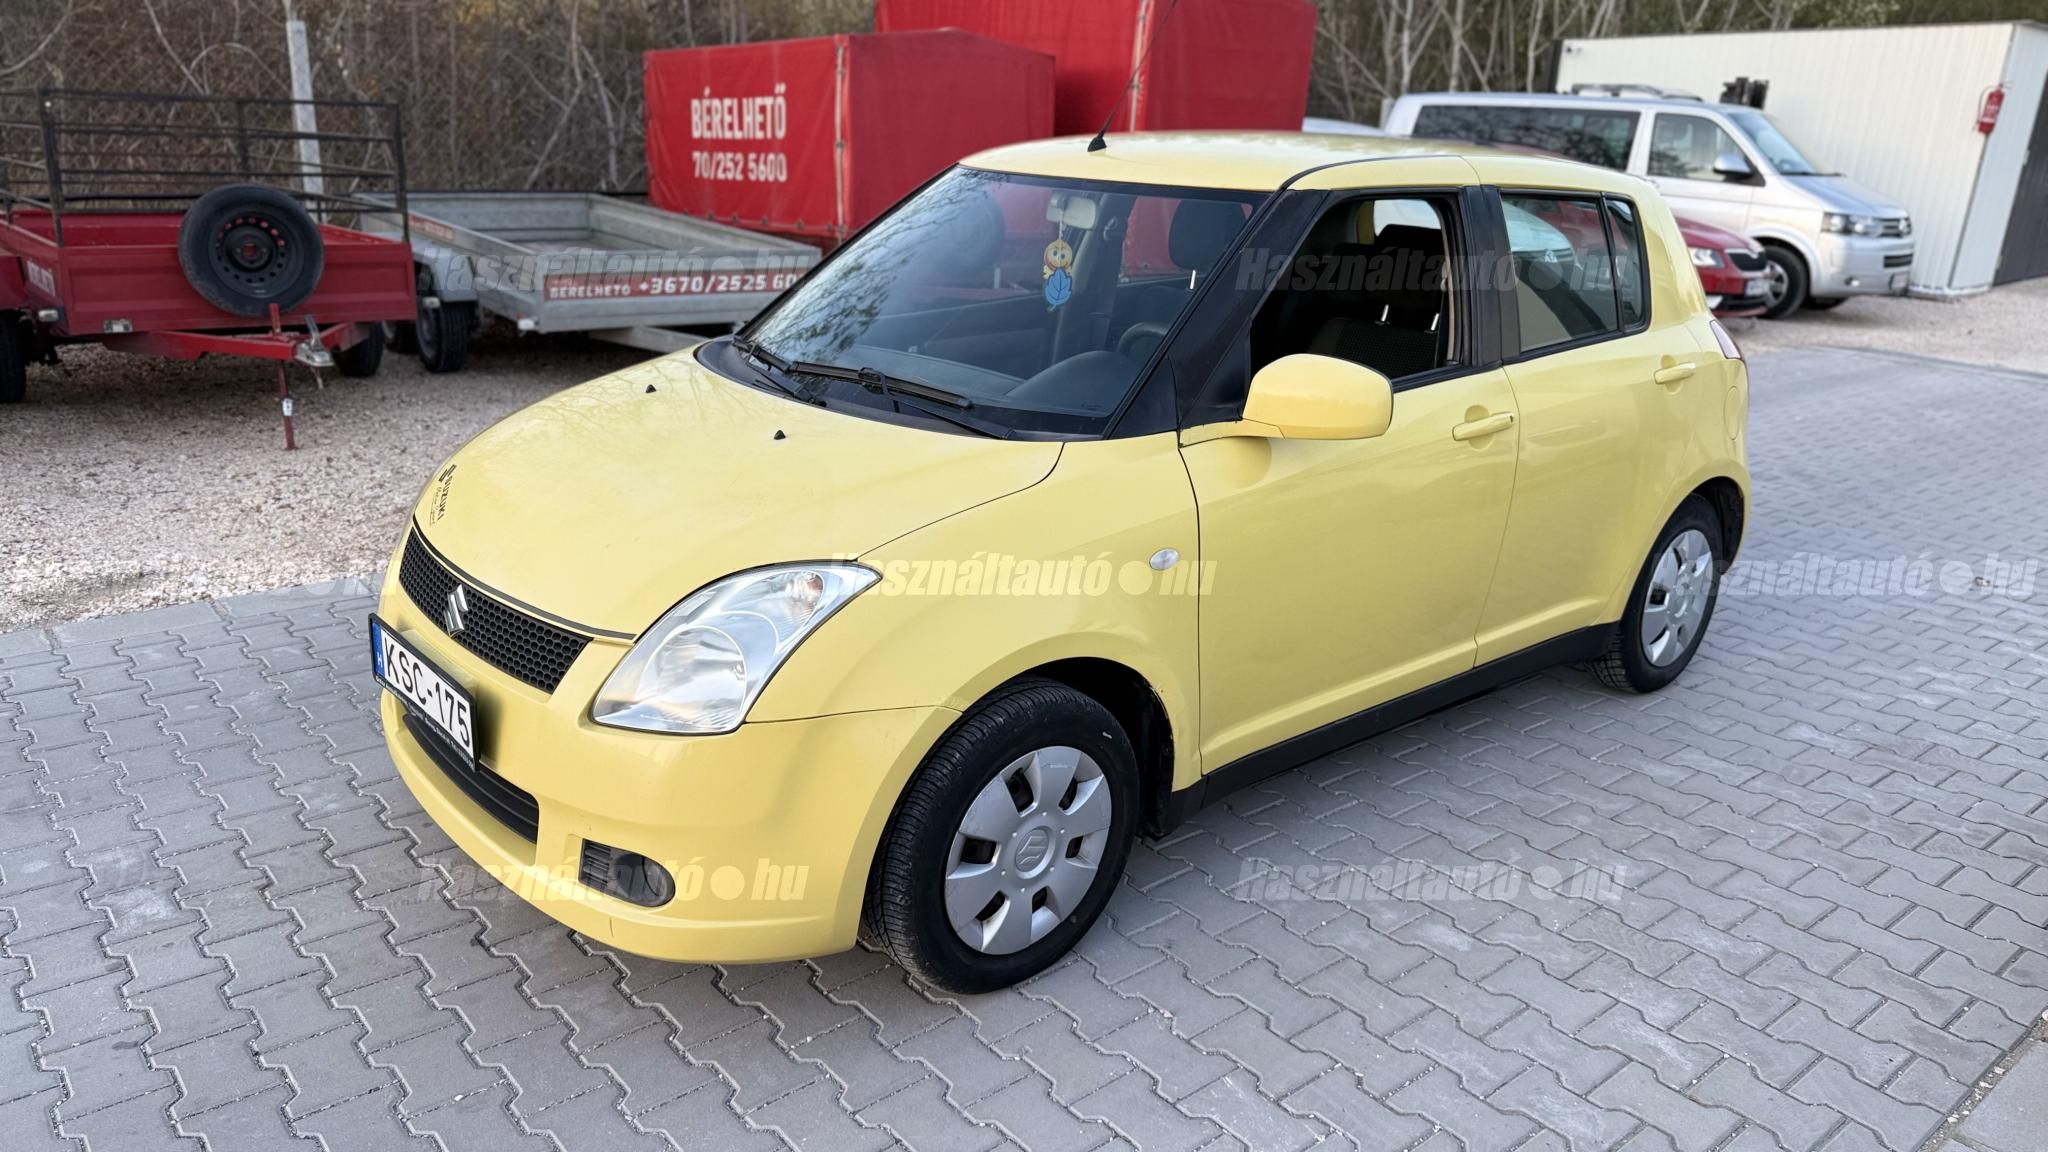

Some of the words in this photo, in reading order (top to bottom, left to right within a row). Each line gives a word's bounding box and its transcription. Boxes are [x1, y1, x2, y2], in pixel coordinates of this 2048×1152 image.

[690, 82, 787, 140] BÉRELHETŐ
[692, 150, 745, 181] 70/252
[747, 151, 788, 182] 5600
[772, 273, 803, 290] 60
[437, 475, 453, 521] SUZUKI
[376, 651, 383, 668] H
[384, 636, 470, 748] KSC-175
